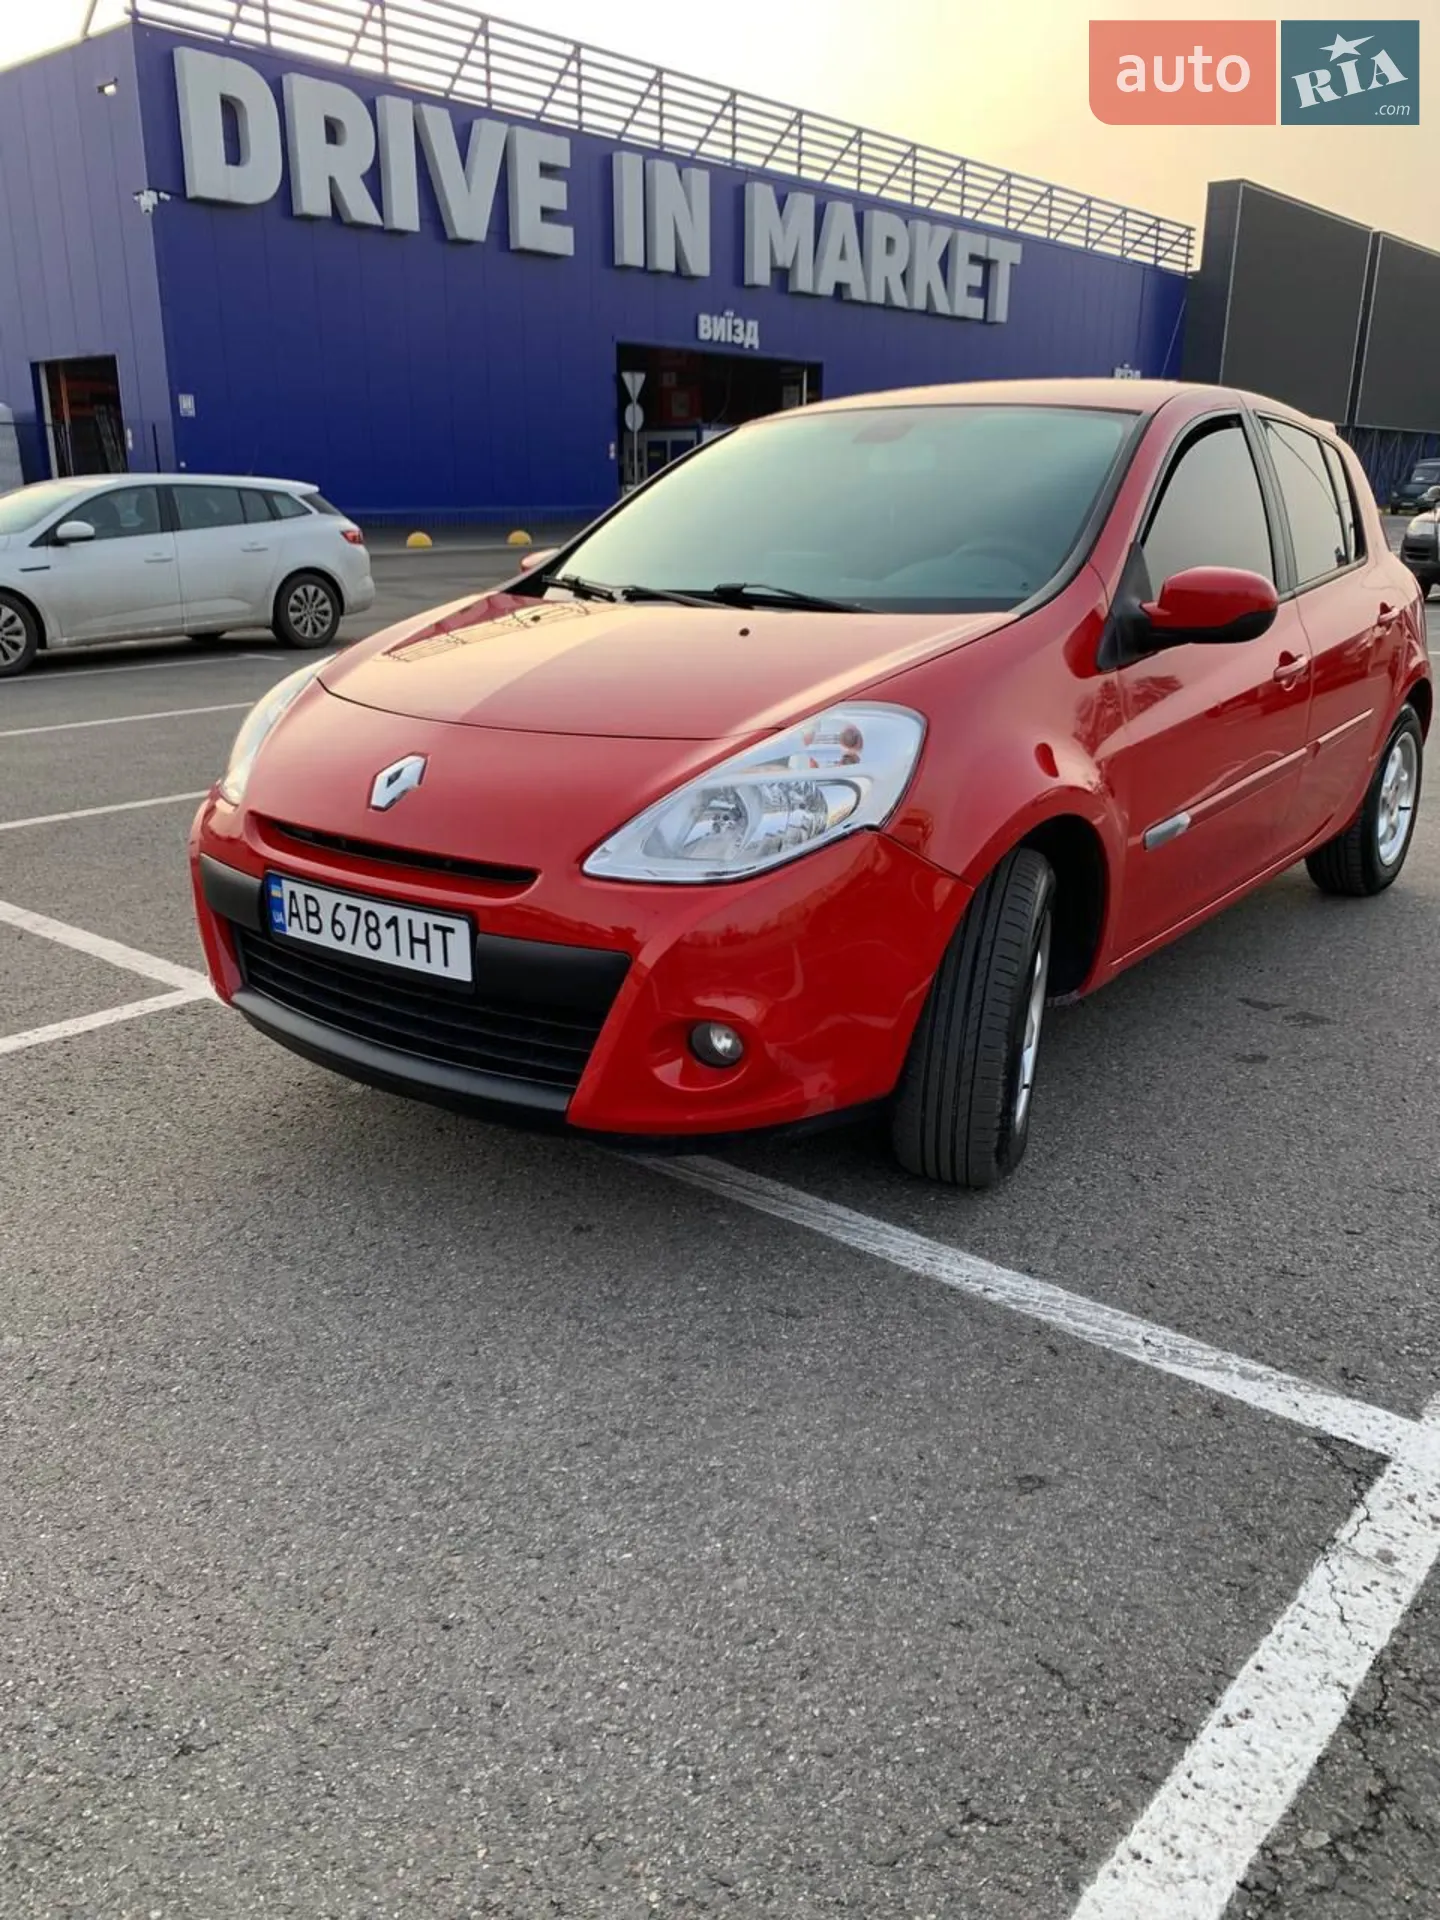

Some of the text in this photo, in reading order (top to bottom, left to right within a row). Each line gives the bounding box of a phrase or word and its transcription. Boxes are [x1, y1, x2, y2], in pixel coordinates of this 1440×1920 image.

[174, 46, 1022, 323] DRIVE IN MARKET
